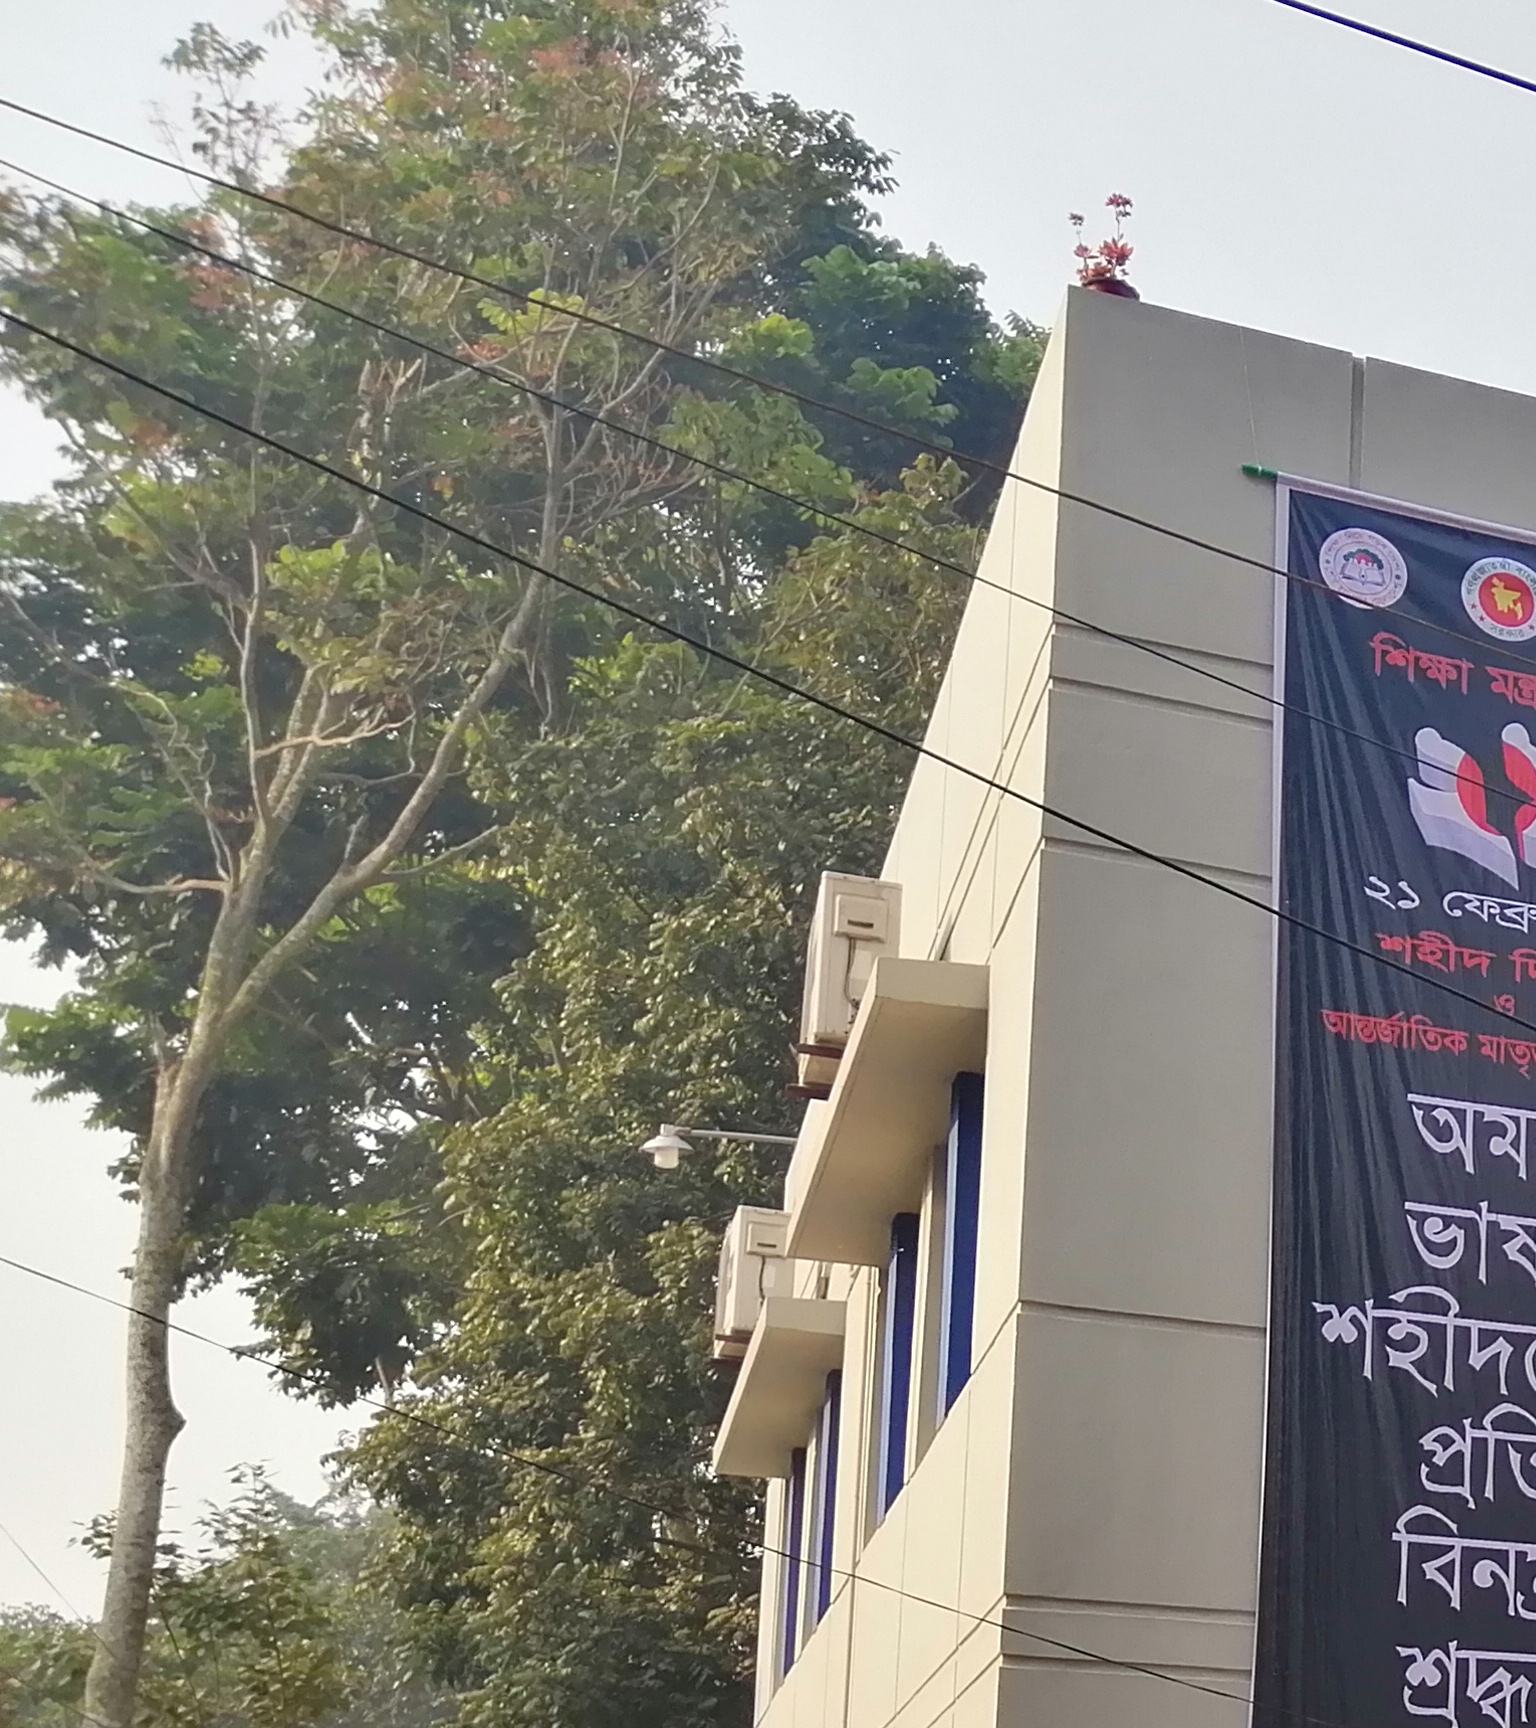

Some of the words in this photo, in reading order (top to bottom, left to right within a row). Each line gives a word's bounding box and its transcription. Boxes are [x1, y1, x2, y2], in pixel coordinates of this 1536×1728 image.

[1368, 632, 1474, 695] শিক্ষা
[1363, 874, 1420, 910] ২১
[1375, 930, 1496, 977] শহীদ
[1493, 994, 1516, 1017] ও
[1320, 1008, 1469, 1056] আন্তর্জাতিক
